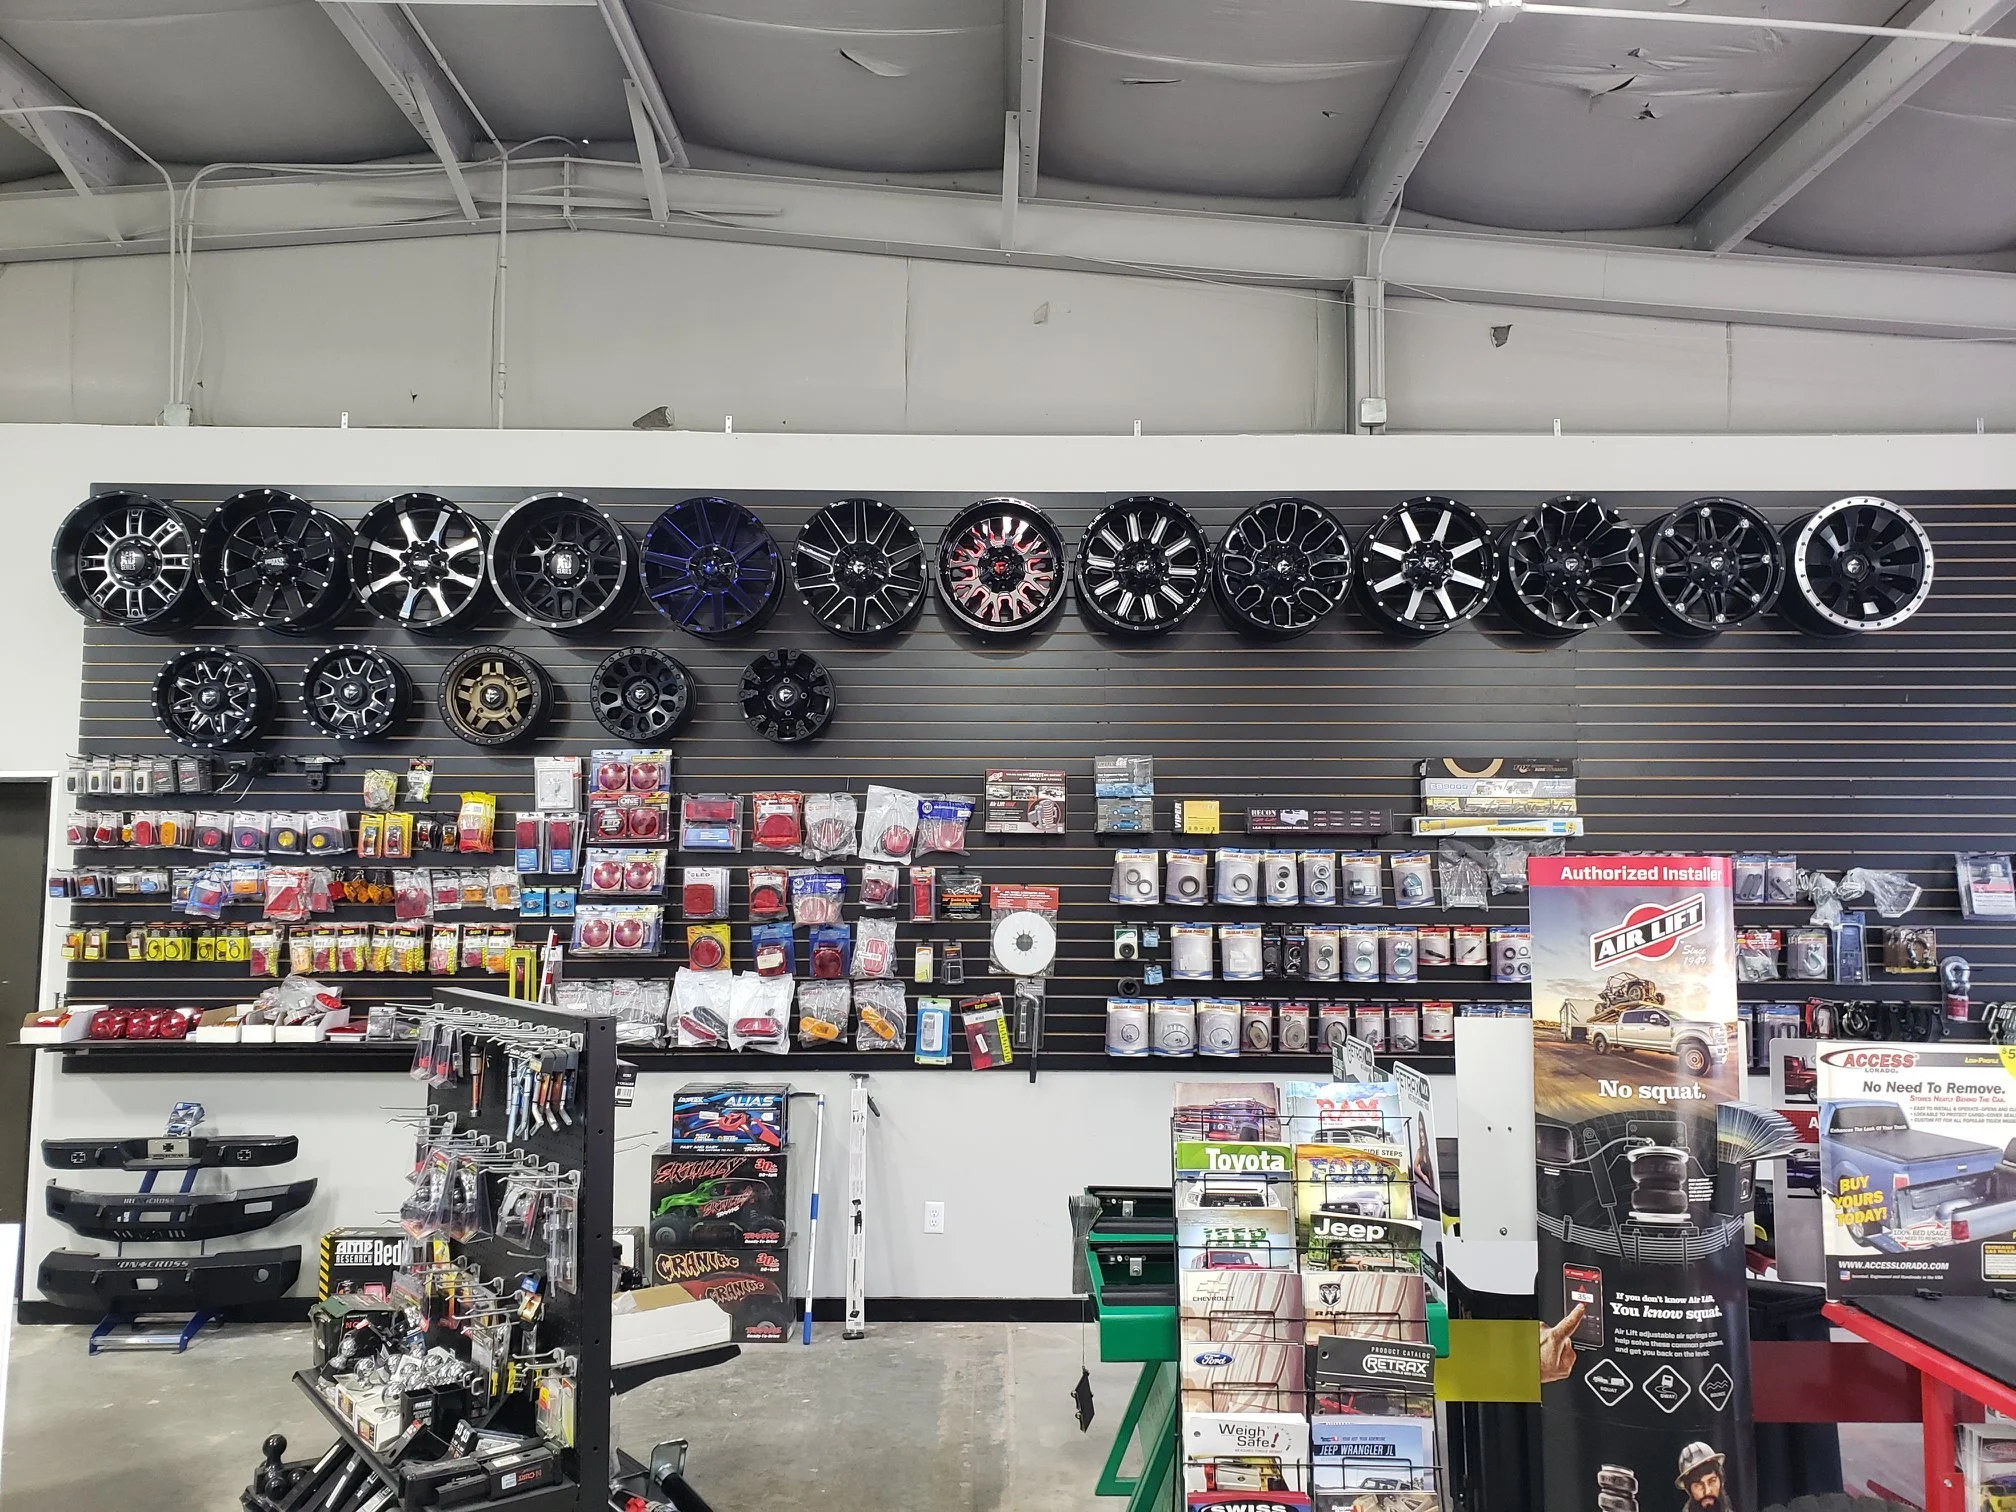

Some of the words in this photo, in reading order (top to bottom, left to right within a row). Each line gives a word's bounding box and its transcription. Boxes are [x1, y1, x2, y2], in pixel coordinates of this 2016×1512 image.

[1174, 802, 1182, 829] VIPER
[1251, 809, 1277, 817] RECON
[1560, 866, 1659, 880] Authorized
[1663, 866, 1722, 881] Installer
[1598, 929, 1646, 960] AIR
[1651, 904, 1701, 937] LIFT
[1682, 944, 1707, 956] Since
[1683, 956, 1707, 966] 1949
[1842, 1053, 1916, 1068] ACCESS
[1597, 1079, 1633, 1098] No
[1638, 1082, 1707, 1104] squat.
[1863, 1081, 1882, 1093] No
[1886, 1081, 1922, 1093] Need
[1927, 1082, 1942, 1093] To
[1946, 1082, 2006, 1095] Remove.
[724, 1096, 775, 1107] ALIAS
[1316, 1098, 1380, 1122] RAM
[1205, 1147, 1284, 1171] Toyota
[1381, 1149, 1403, 1158] STEPS
[1839, 1175, 1870, 1194] BUY
[1832, 1190, 1885, 1209] YOURS
[1836, 1206, 1888, 1226] TODAY!
[1313, 1217, 1385, 1242] Jeep
[336, 1242, 373, 1254] AMP
[335, 1254, 372, 1263] RESEARCH
[655, 1251, 740, 1282] CRANIAC
[1838, 1260, 1950, 1271] WWW.ACCESSLORADO.COM
[1615, 1292, 1624, 1300] If
[1625, 1294, 1641, 1304] you
[1642, 1294, 1664, 1304] don't
[1665, 1294, 1687, 1304] know
[1688, 1296, 1700, 1304] Air
[1610, 1302, 1640, 1317] You
[1643, 1303, 1683, 1320] know
[1685, 1307, 1722, 1322] squat.
[1626, 1328, 1638, 1336] Lift
[1639, 1330, 1675, 1339] adjustable
[1686, 1331, 1708, 1340] springs
[1614, 1337, 1630, 1345] help
[1630, 1338, 1650, 1346] solve
[1650, 1340, 1671, 1348] these
[1371, 1346, 1400, 1355] PRODUCT
[1402, 1349, 1431, 1359] CATALOG
[1656, 1349, 1673, 1357] back
[1683, 1350, 1694, 1358] the
[1198, 1353, 1229, 1366] Ford
[1363, 1354, 1428, 1375] RETRAX
[1600, 1386, 1618, 1394] SQUAT
[1219, 1424, 1266, 1439] Weigh
[1320, 1445, 1338, 1455] JEEP
[1341, 1444, 1383, 1455] WRANGLER
[1385, 1445, 1394, 1456] JL
